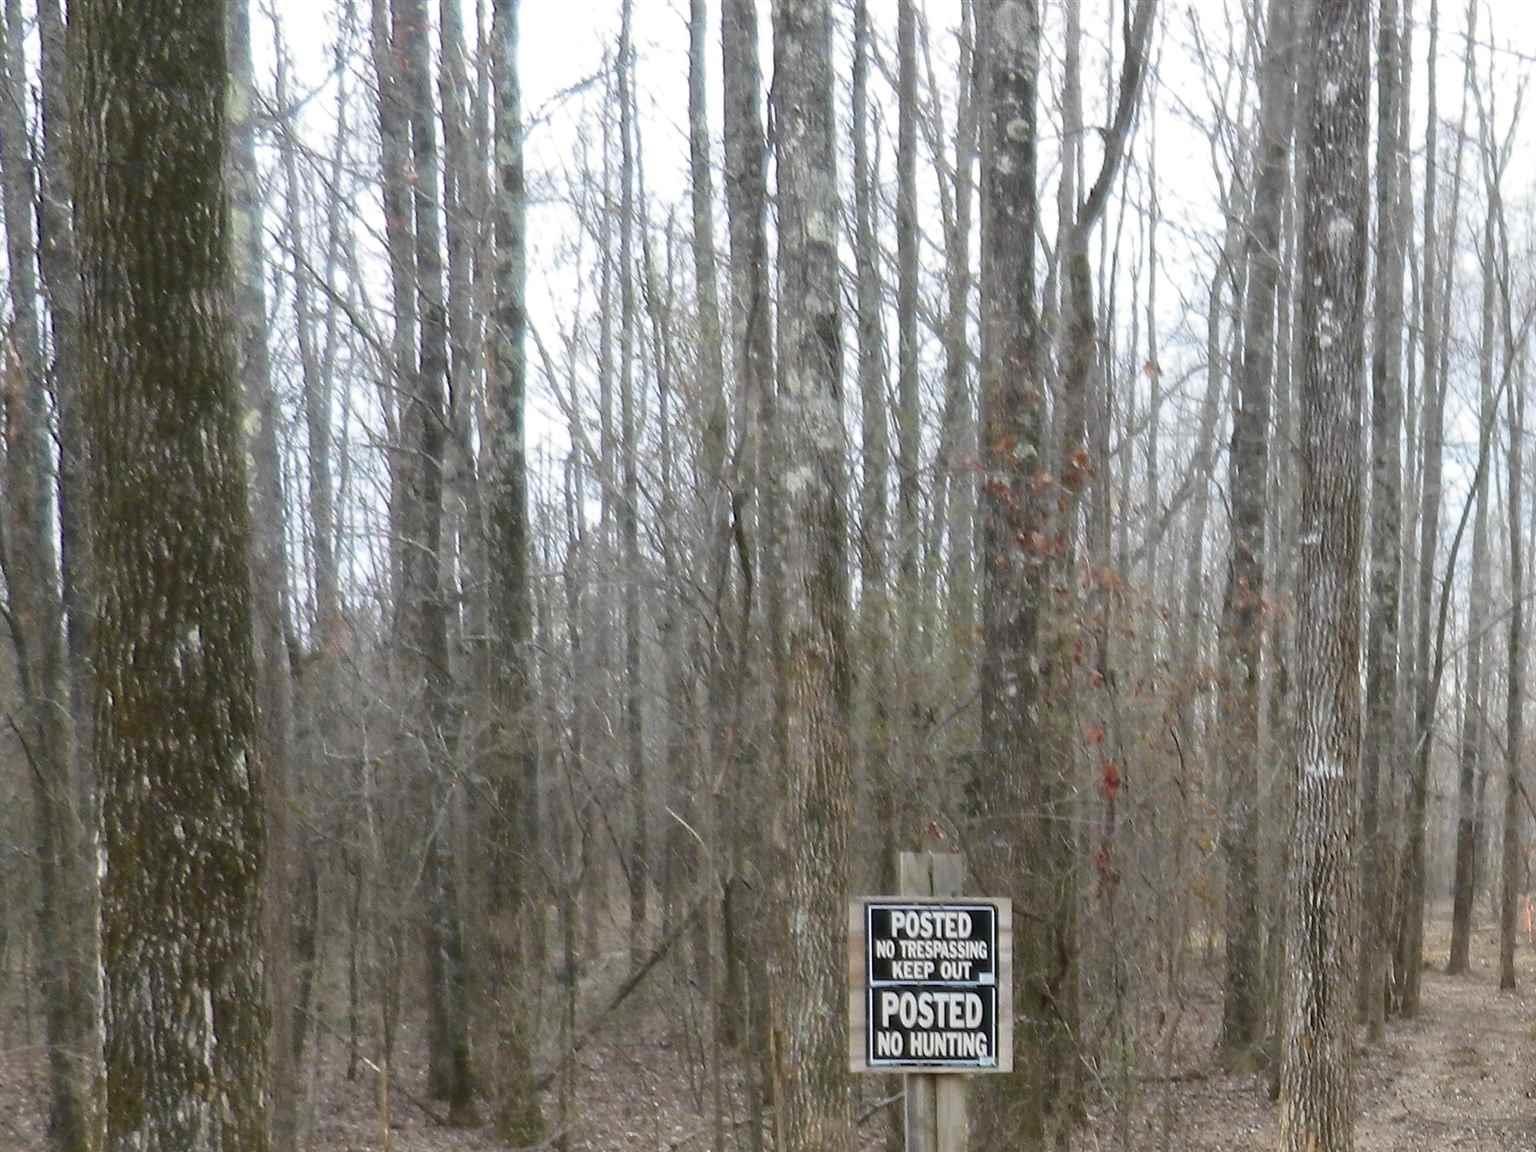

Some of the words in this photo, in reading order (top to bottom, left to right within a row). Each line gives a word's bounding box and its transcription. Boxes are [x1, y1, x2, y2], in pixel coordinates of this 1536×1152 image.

[891, 911, 972, 939] POSTED
[876, 940, 895, 958] NO
[900, 940, 988, 960] TRESPASSING
[892, 961, 935, 980] KEEP
[940, 961, 972, 980] OUT
[882, 991, 983, 1029] POSTED
[877, 1031, 903, 1057] NO
[910, 1031, 988, 1057] HUNTING
